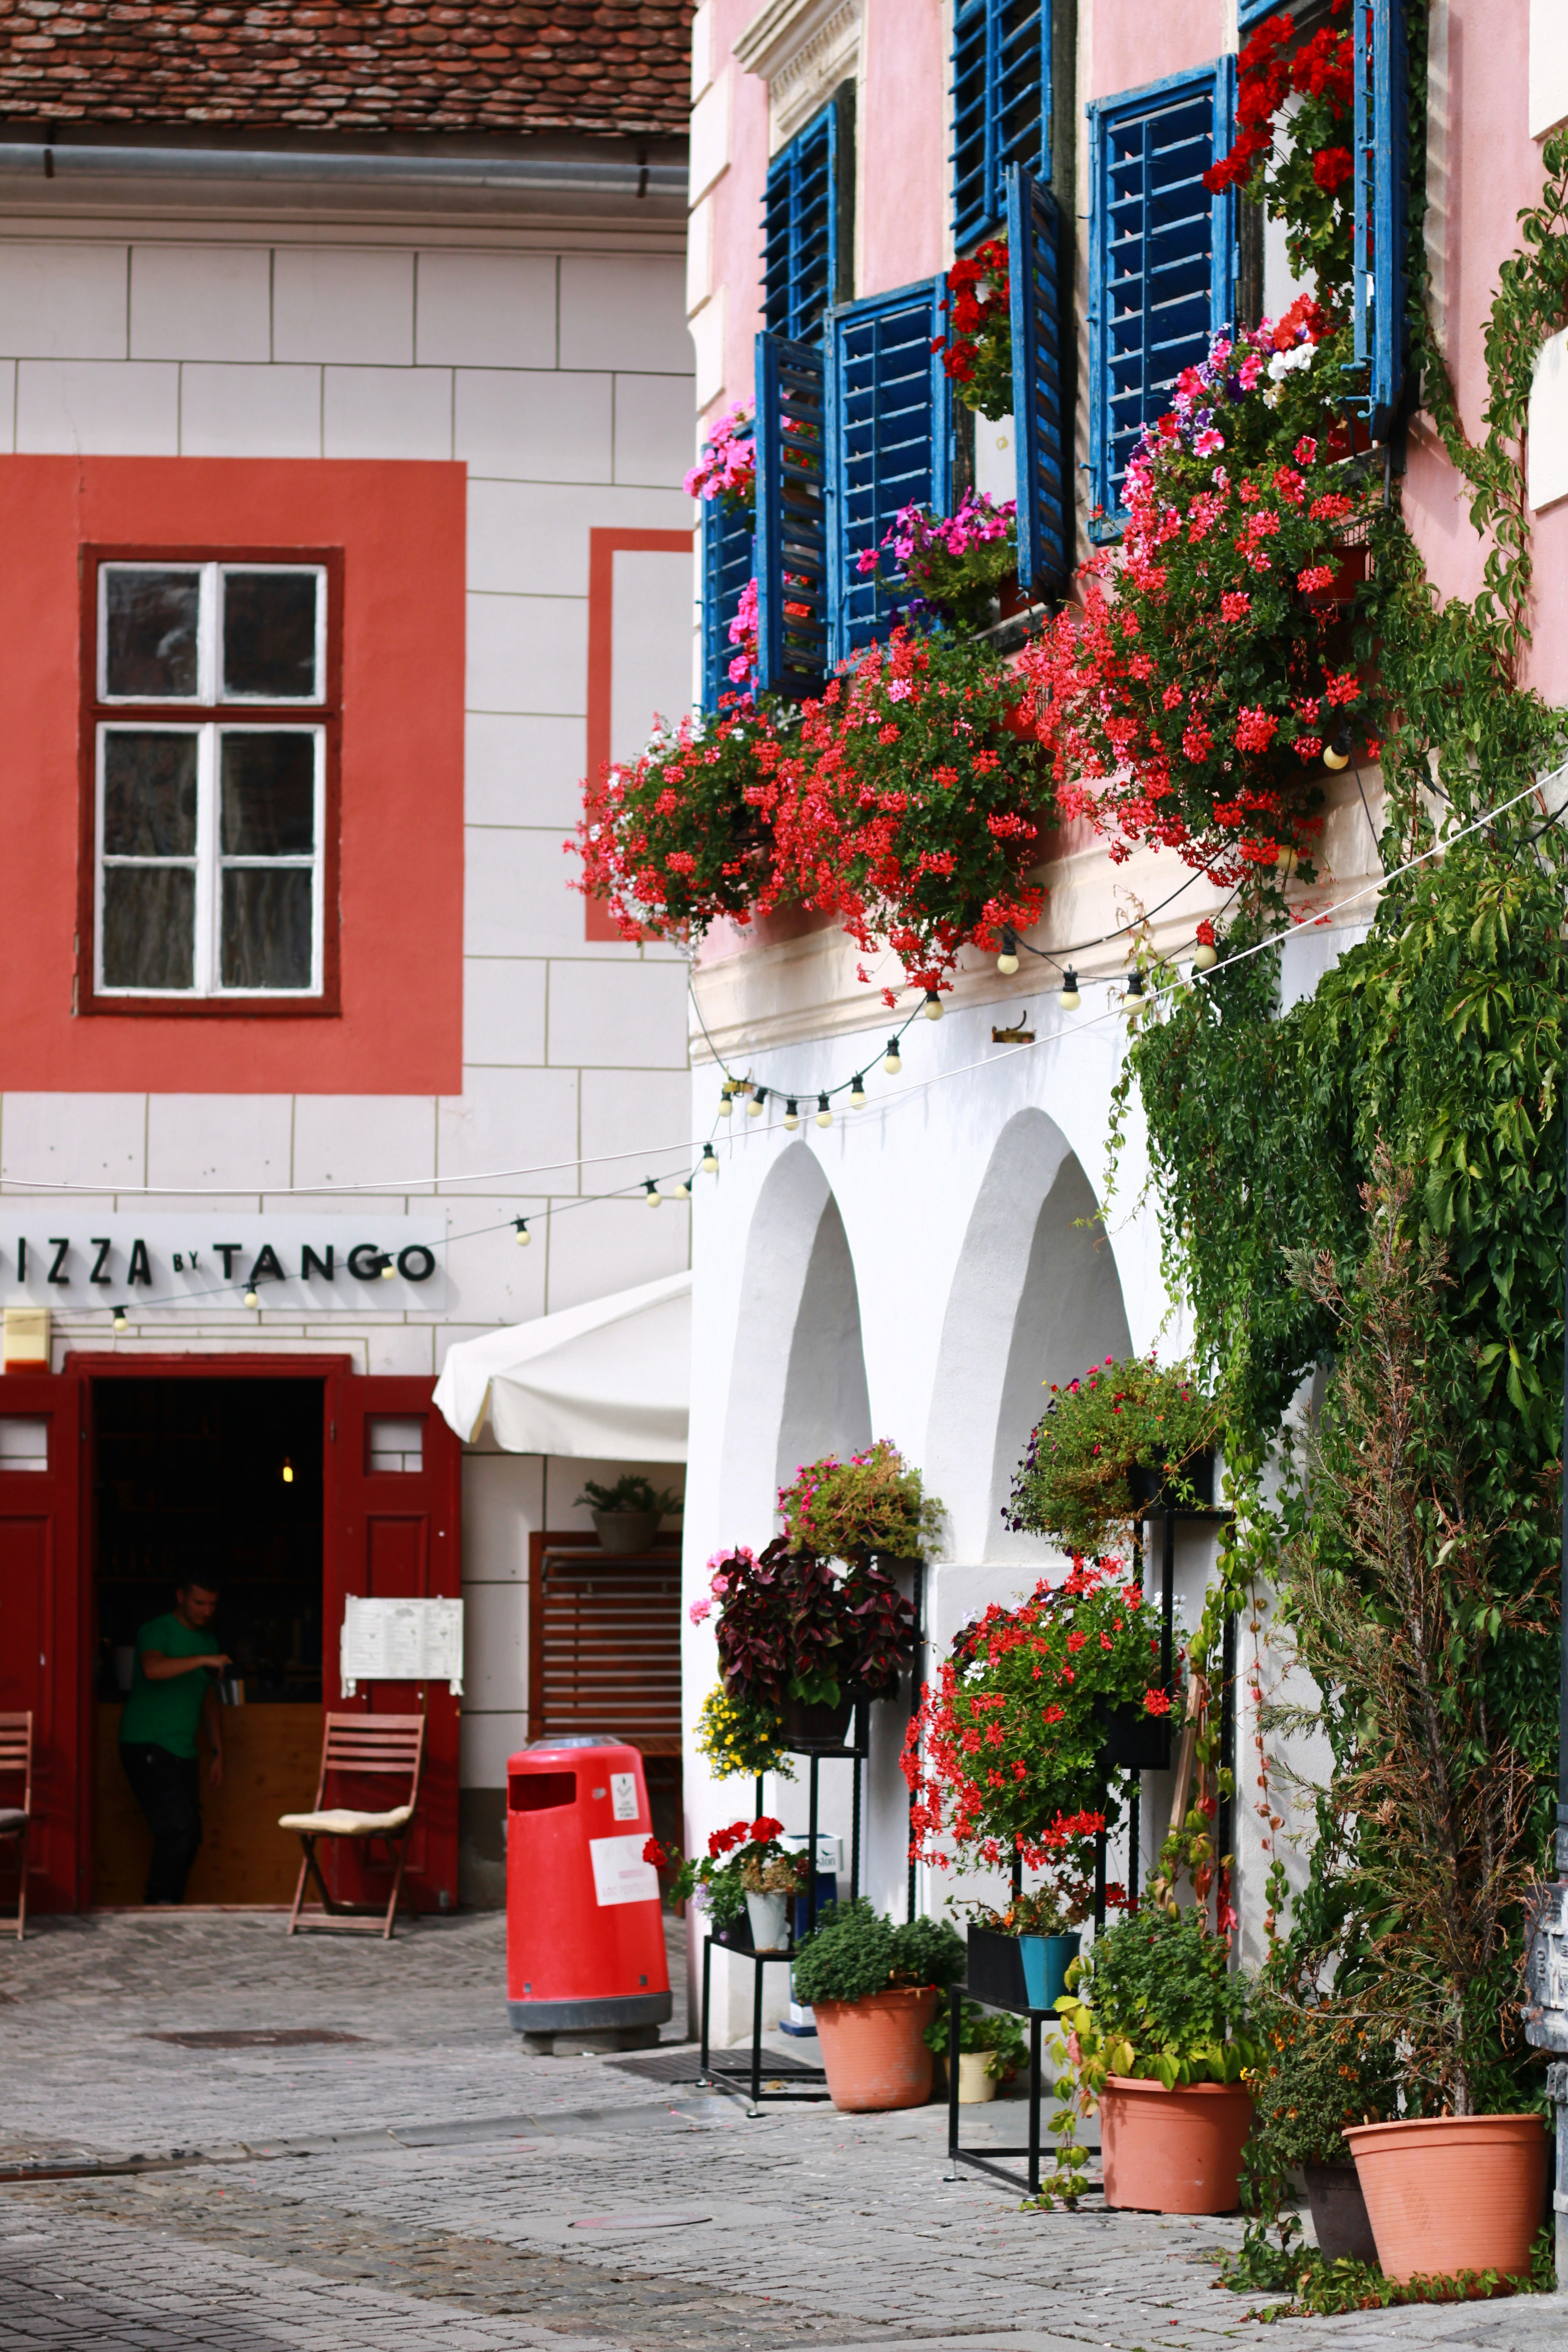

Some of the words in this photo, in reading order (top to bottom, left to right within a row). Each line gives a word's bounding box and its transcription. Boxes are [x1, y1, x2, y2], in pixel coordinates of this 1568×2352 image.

[18, 1237, 152, 1285] IZZA
[173, 1250, 198, 1272] BY
[212, 1243, 436, 1281] TANGO
